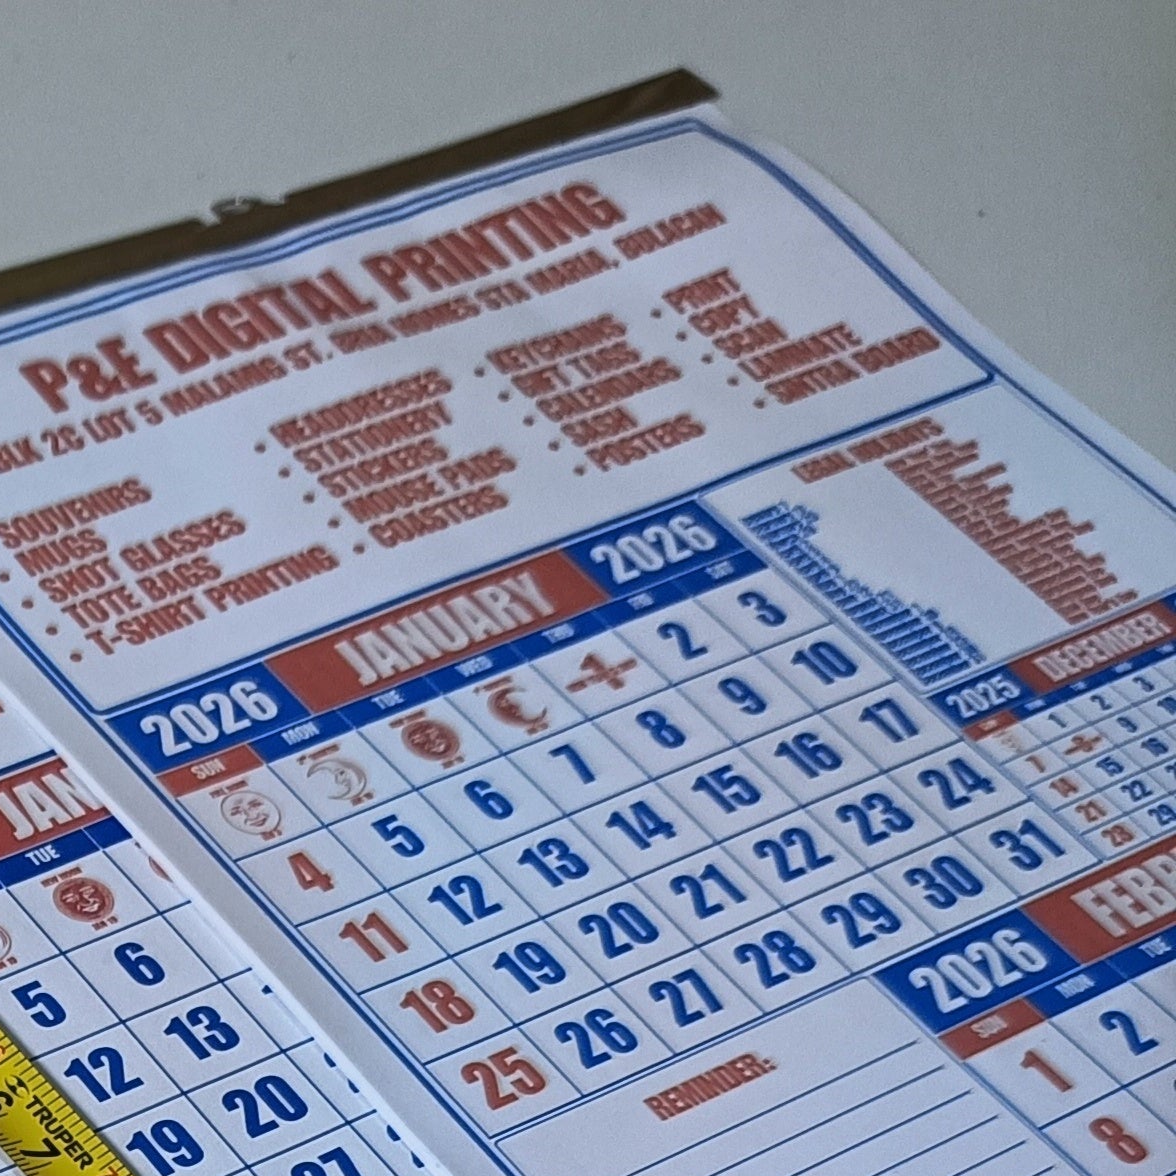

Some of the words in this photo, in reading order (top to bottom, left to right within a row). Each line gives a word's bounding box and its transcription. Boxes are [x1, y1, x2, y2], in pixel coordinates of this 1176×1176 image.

[18, 334, 158, 414] P&E
[142, 267, 378, 375] DIGITAL
[360, 181, 627, 302] PRINTING
[40, 424, 85, 457] 2C
[82, 408, 136, 444] LOT
[135, 400, 164, 426] 5
[585, 413, 706, 472] POSTERS
[317, 437, 449, 498] STICKERS
[436, 449, 518, 490] PADS
[368, 485, 509, 548] COASTERS
[14, 529, 108, 577] MUGS
[38, 557, 120, 603] SHOT
[119, 509, 246, 573] GLASSES
[61, 585, 142, 629] TOTE
[136, 556, 222, 603] BAGS
[85, 596, 206, 655] T-SHIRT
[203, 544, 340, 613] PRINTING
[139, 679, 279, 758] 2026
[333, 571, 556, 688] JANUARY
[589, 515, 717, 585] 2026
[945, 675, 1023, 719] 2025
[1032, 612, 1174, 682] DECEMBER
[191, 758, 227, 781] SUN
[280, 722, 321, 746] MON
[550, 743, 596, 784] 7
[694, 764, 762, 812] 15
[25, 844, 61, 866] TUE
[754, 827, 835, 882] 22
[991, 819, 1065, 871] 31
[114, 942, 165, 986] 6
[908, 928, 1049, 1015] 2026
[164, 1006, 240, 1060] 13
[641, 1051, 779, 1122] REMINDER:
[26, 1095, 94, 1171] TRUPER
